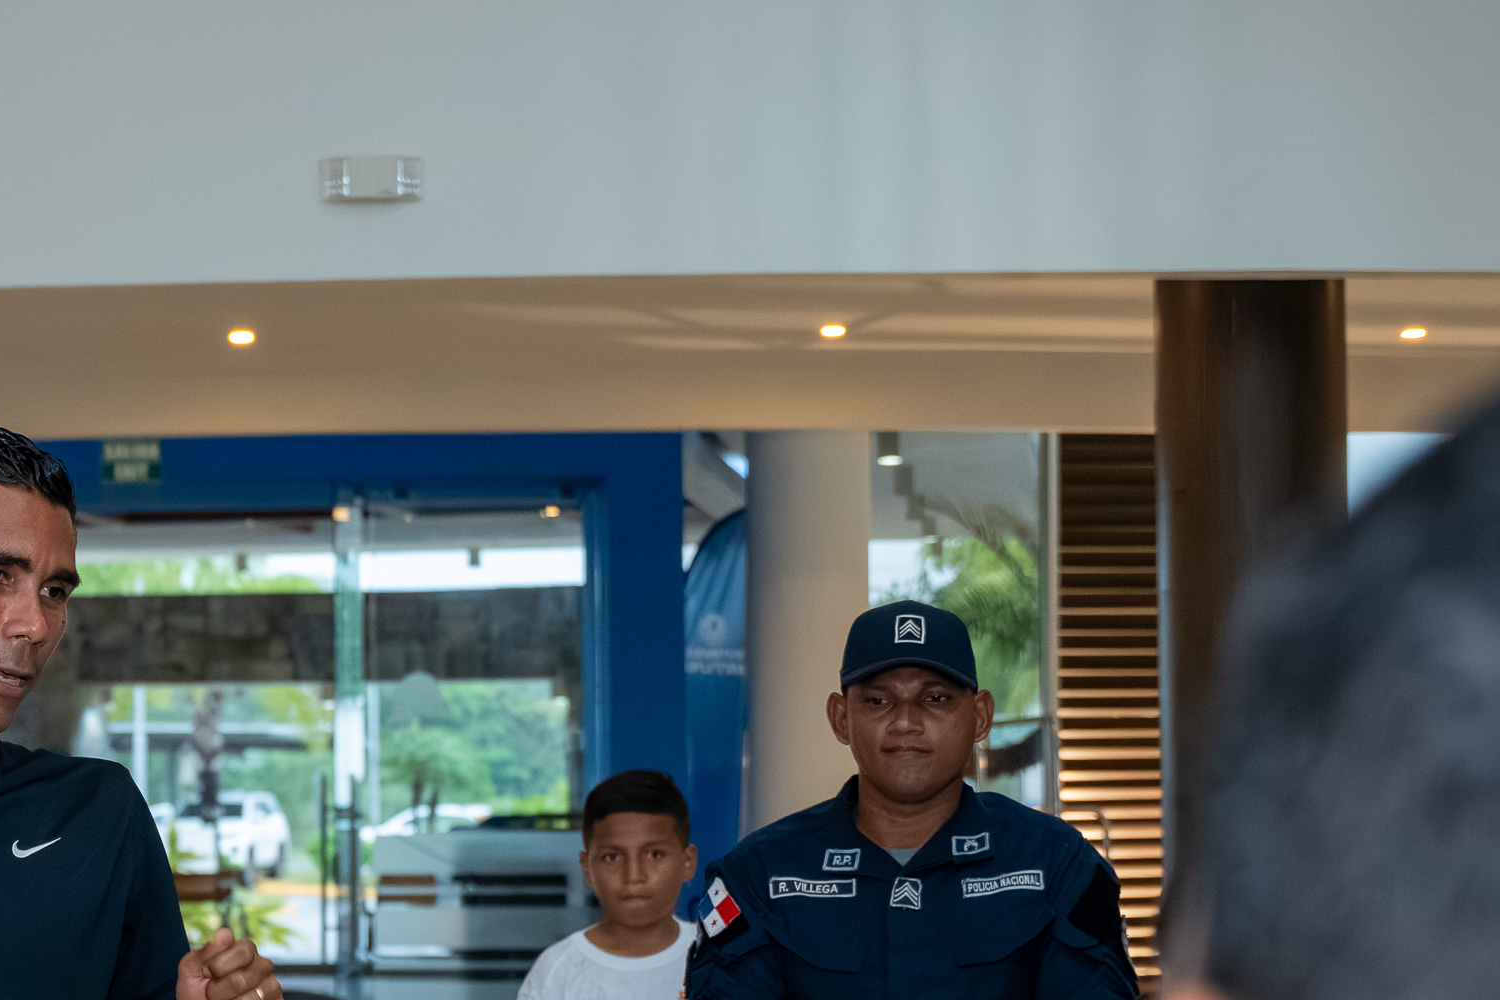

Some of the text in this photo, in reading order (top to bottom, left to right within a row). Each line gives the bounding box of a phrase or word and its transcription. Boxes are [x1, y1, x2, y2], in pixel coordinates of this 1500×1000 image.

[832, 855, 852, 866] R.P.
[778, 881, 838, 894] R. VILLEGA
[967, 874, 1040, 893] POLICIA NACIONAL
